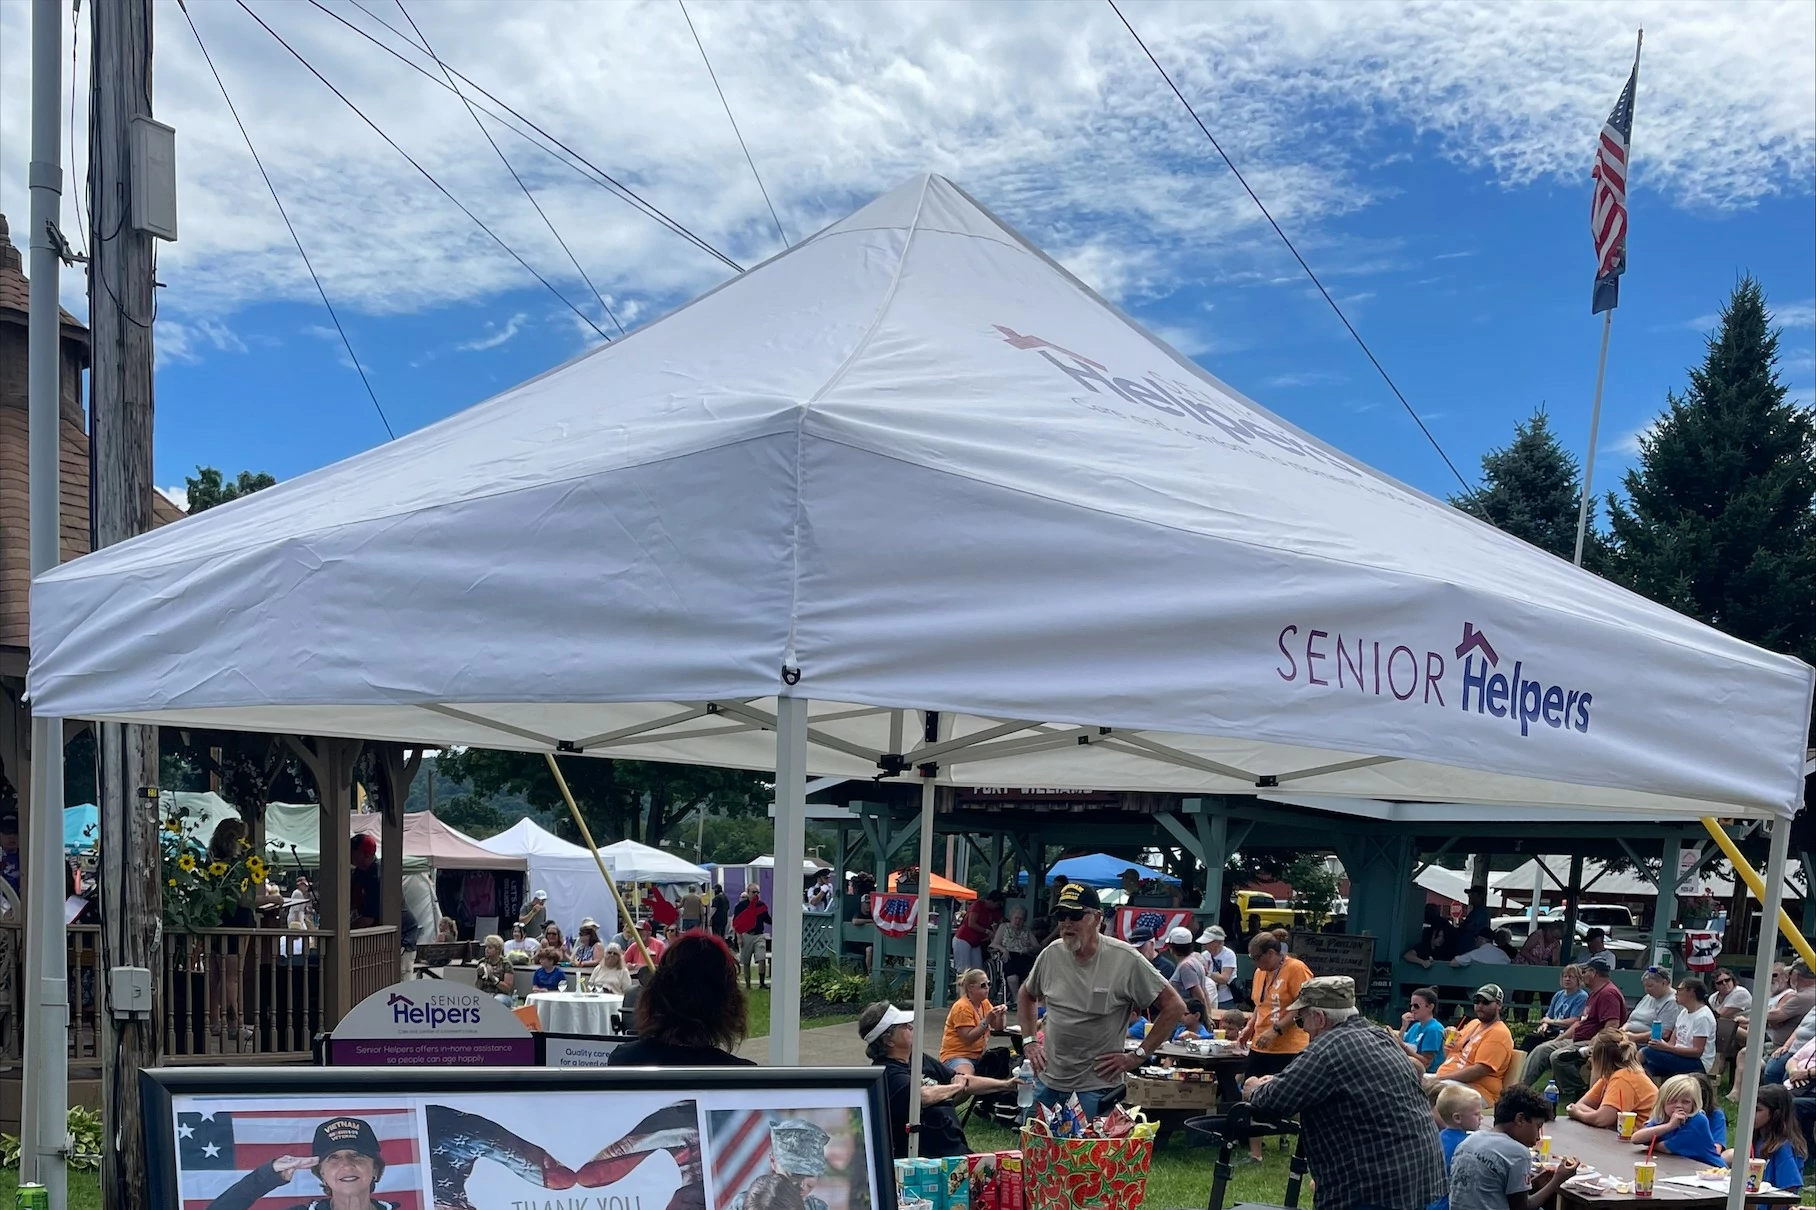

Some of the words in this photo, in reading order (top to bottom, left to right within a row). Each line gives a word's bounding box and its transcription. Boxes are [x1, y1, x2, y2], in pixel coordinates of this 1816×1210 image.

[1277, 625, 1445, 707] SENIOR
[1462, 654, 1593, 737] Helpers
[431, 995, 480, 1007] SENIOR
[394, 1003, 480, 1028] Helpers
[356, 1046, 382, 1054] Senior
[383, 1046, 414, 1054] Helpers
[415, 1045, 439, 1053] offers
[440, 1045, 472, 1053] in-home
[565, 1048, 592, 1058] Quality
[398, 1055, 425, 1065] people
[442, 1056, 457, 1065] age
[324, 1121, 360, 1133] VIETNAM
